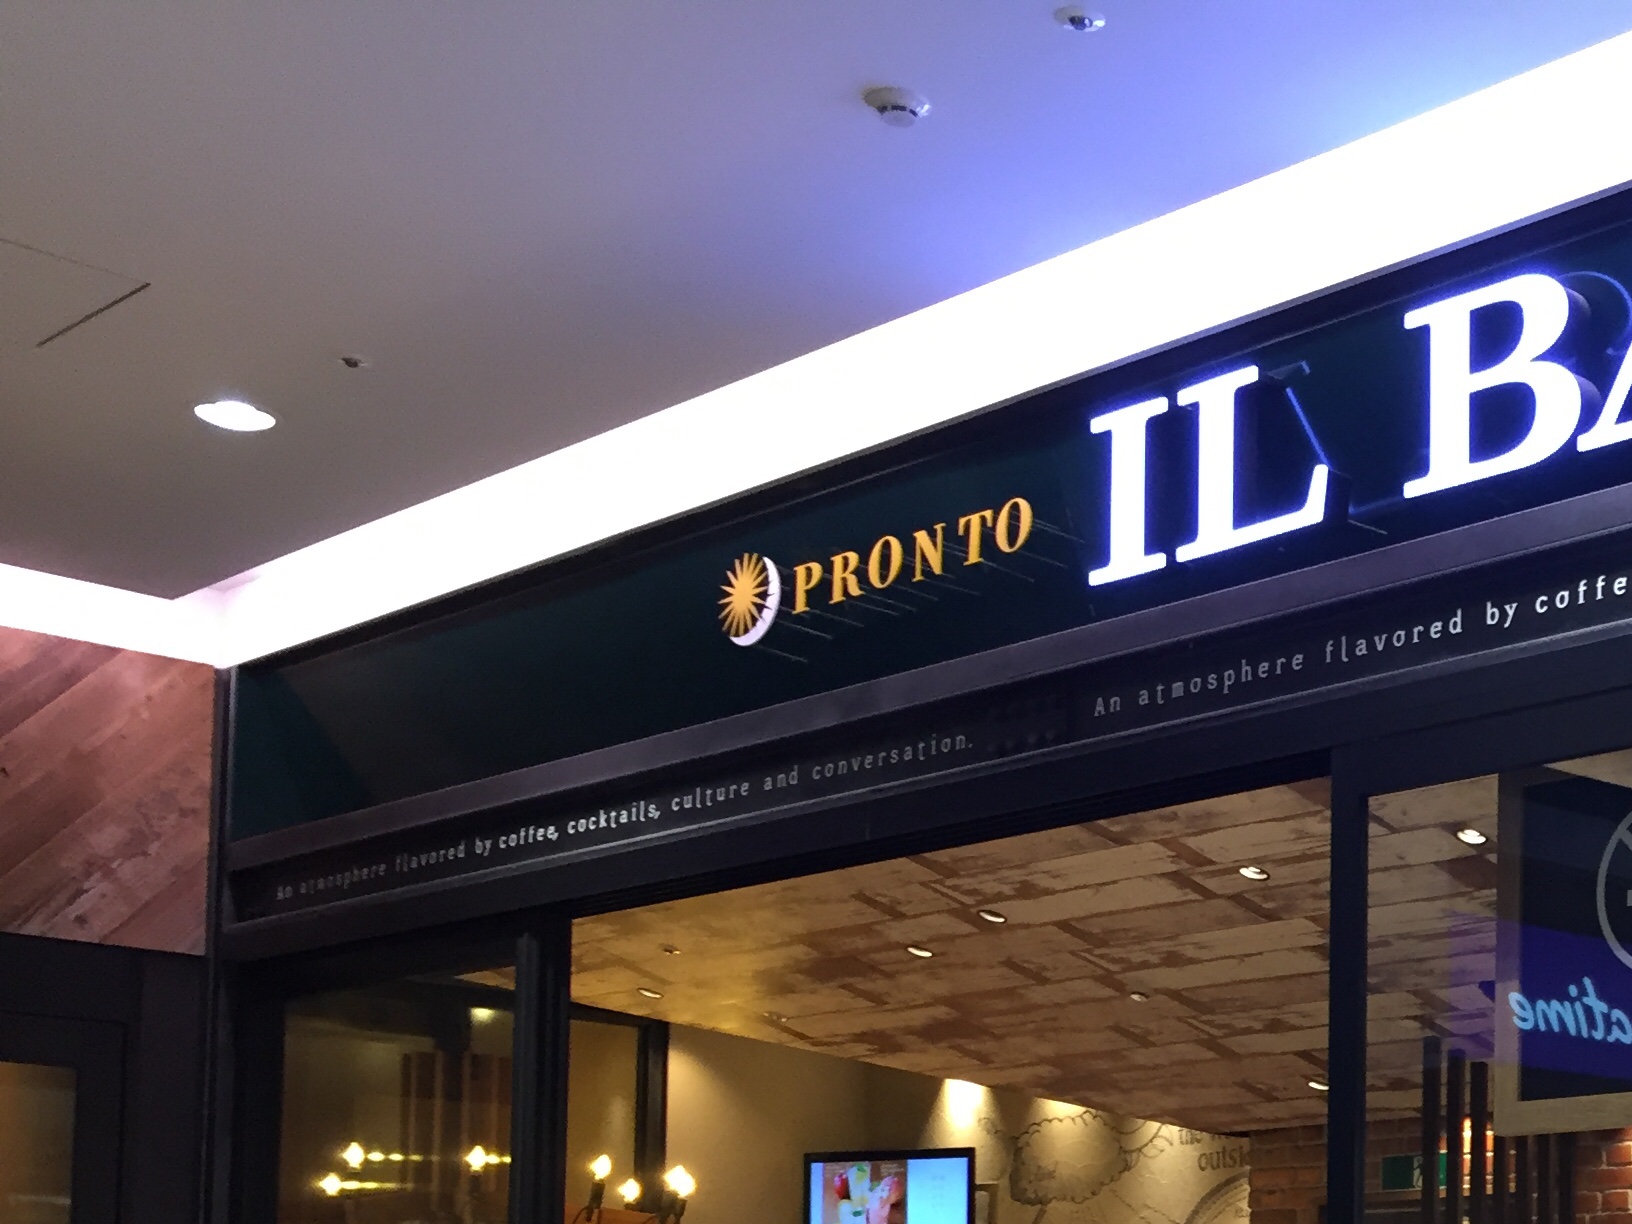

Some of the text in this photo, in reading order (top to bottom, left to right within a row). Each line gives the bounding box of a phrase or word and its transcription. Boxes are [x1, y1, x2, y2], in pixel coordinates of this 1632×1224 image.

[1087, 364, 1330, 588] IL
[792, 496, 1033, 615] PRONTO
[1093, 694, 1122, 718] An
[1137, 648, 1306, 708] atmosphere
[1324, 609, 1465, 667] flavored
[1485, 598, 1520, 628] by
[474, 837, 493, 857] by
[498, 824, 559, 850] coffee,
[566, 798, 661, 835] cocktails,
[671, 780, 750, 811] culture
[763, 764, 799, 792] and
[812, 733, 974, 781] conversation.
